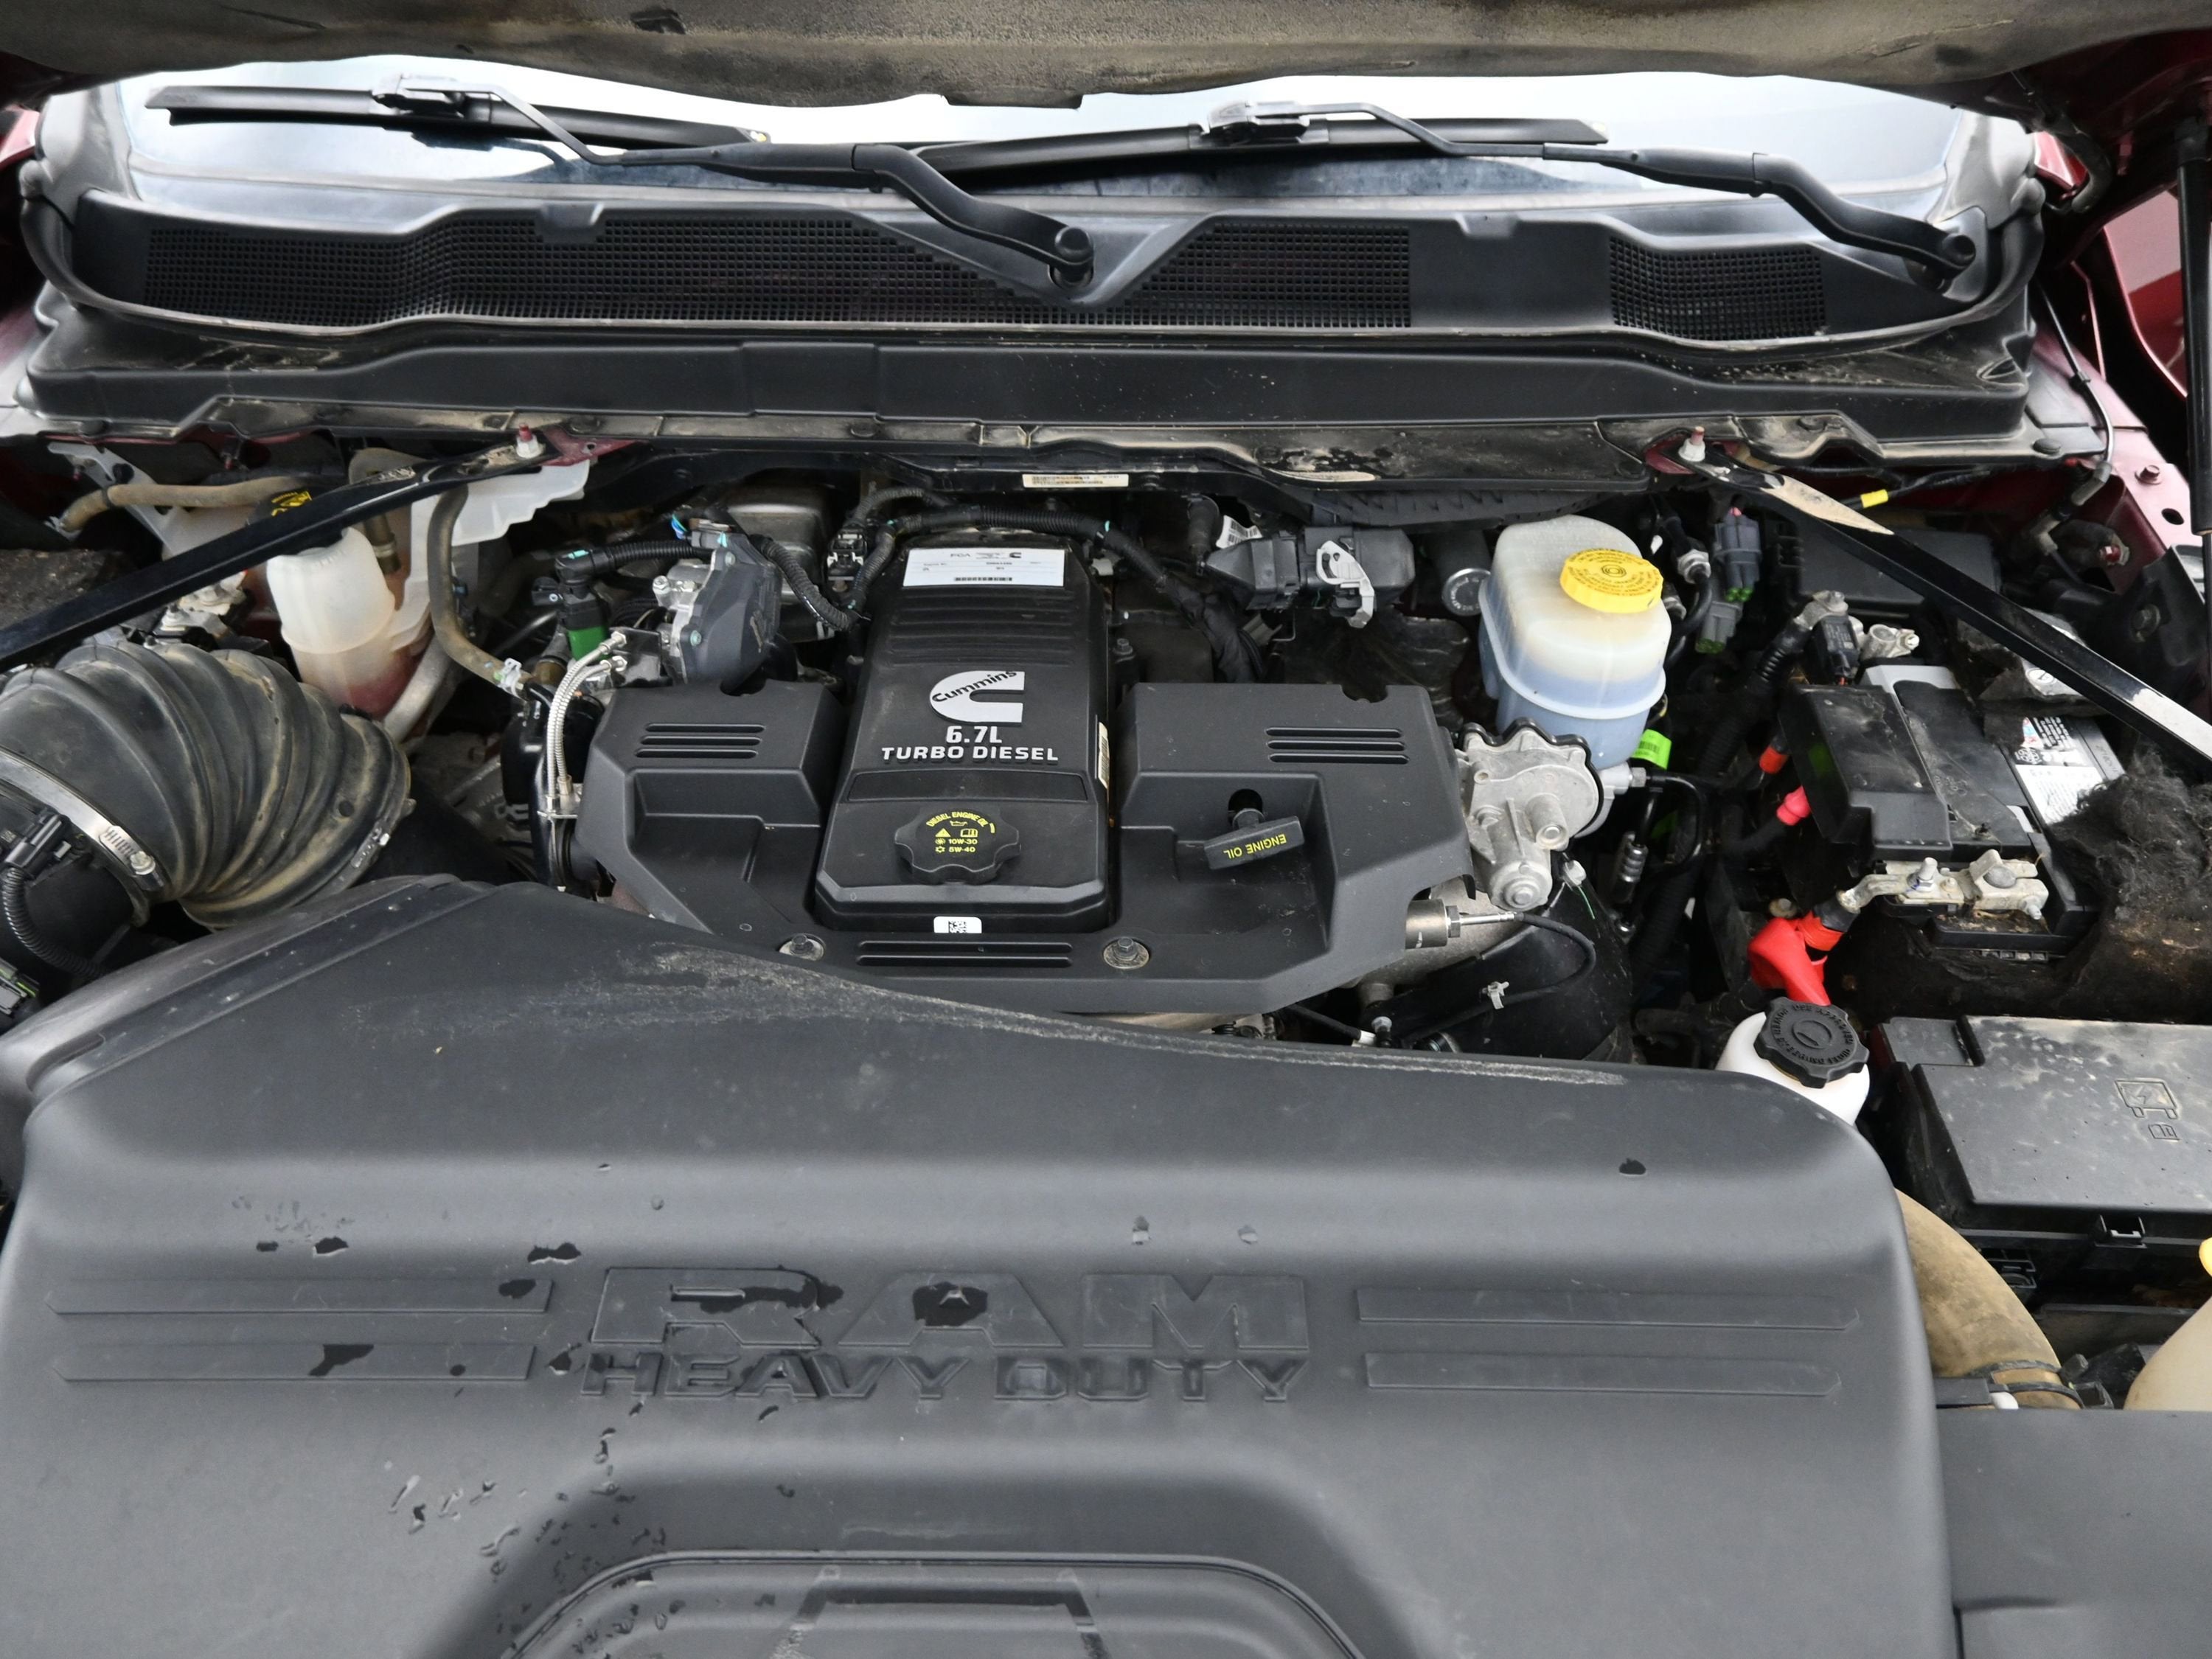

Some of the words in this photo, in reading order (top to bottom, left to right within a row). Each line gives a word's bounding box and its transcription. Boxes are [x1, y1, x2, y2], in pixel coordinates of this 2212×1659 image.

[932, 670, 1017, 702] Cummins
[946, 726, 1002, 743] 6.7L
[882, 746, 964, 760] TURBO
[973, 746, 1059, 761] DIESEL
[926, 813, 951, 827] DIESEL
[951, 812, 981, 821] ENGINE
[1223, 846, 1242, 859] OIL
[1245, 833, 1287, 854] ENGINE
[590, 1267, 1310, 1350] RAM
[580, 1352, 970, 1399] HEAVY
[993, 1354, 1310, 1401] DUTY
